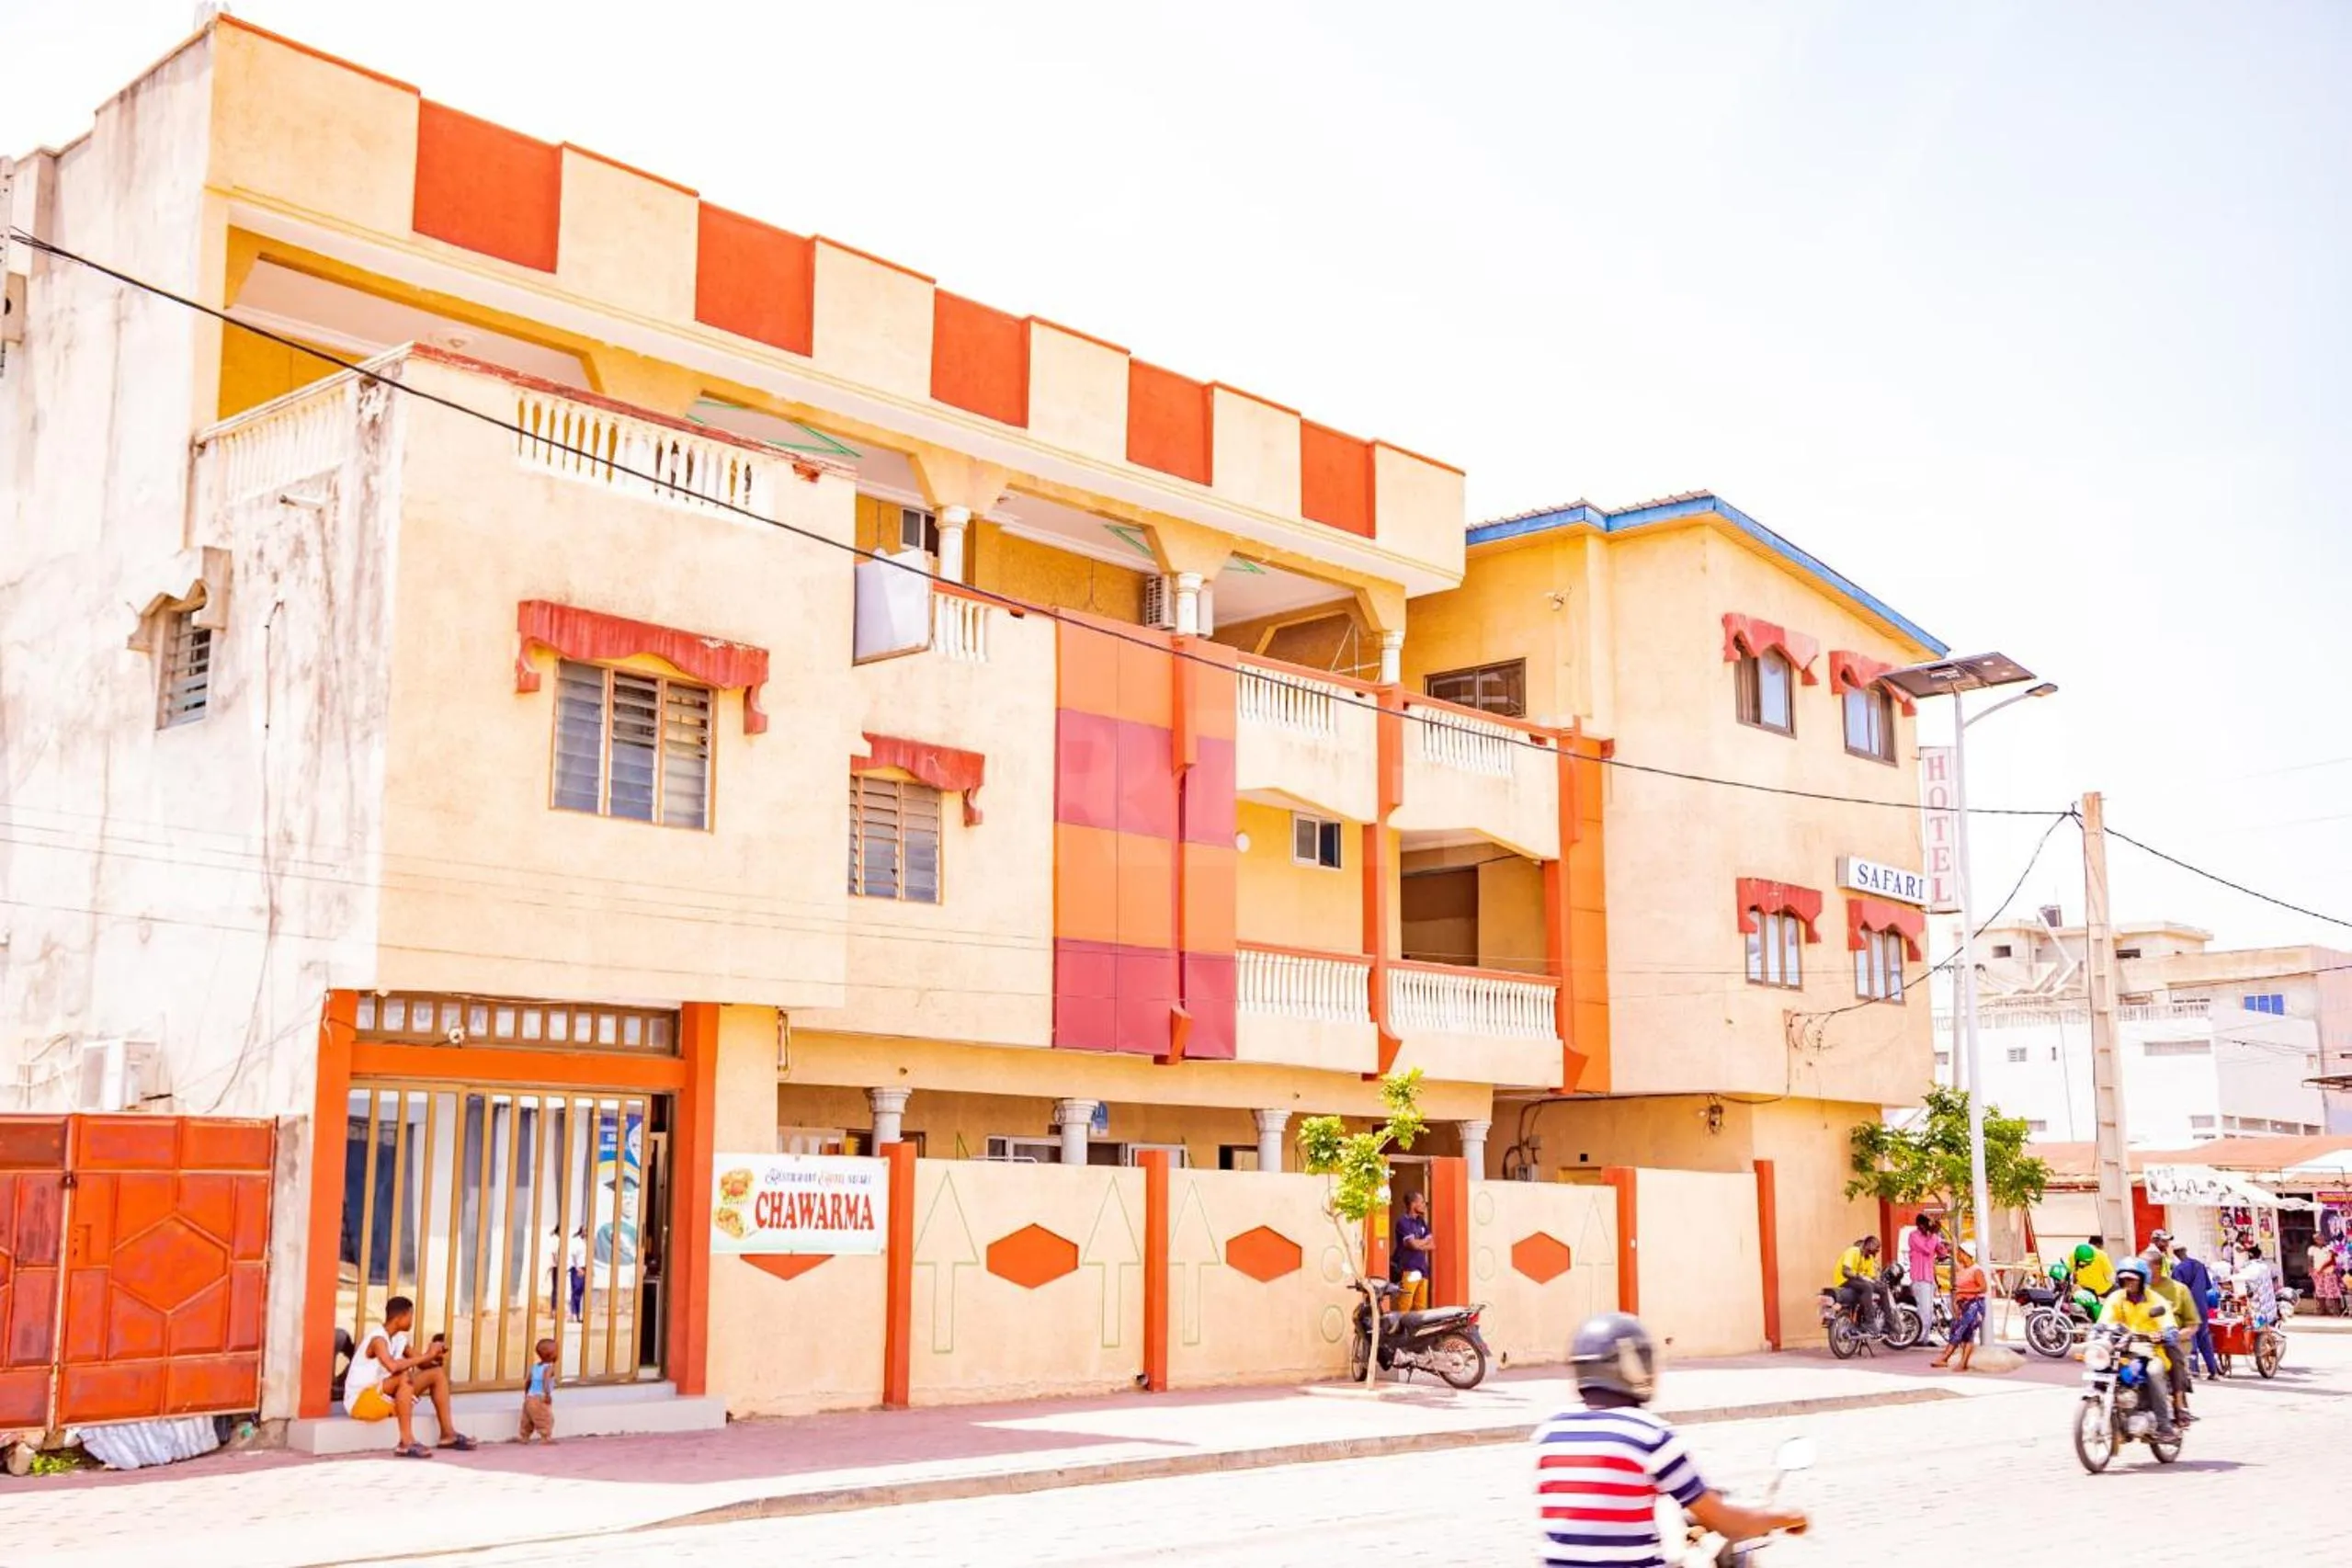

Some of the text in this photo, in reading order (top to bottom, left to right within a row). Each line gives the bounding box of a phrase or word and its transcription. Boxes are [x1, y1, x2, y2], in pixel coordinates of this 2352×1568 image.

[1926, 755, 1952, 903] HOTEL
[1858, 863, 1925, 900] SAFARI
[755, 1191, 875, 1230] CHAWARMA
